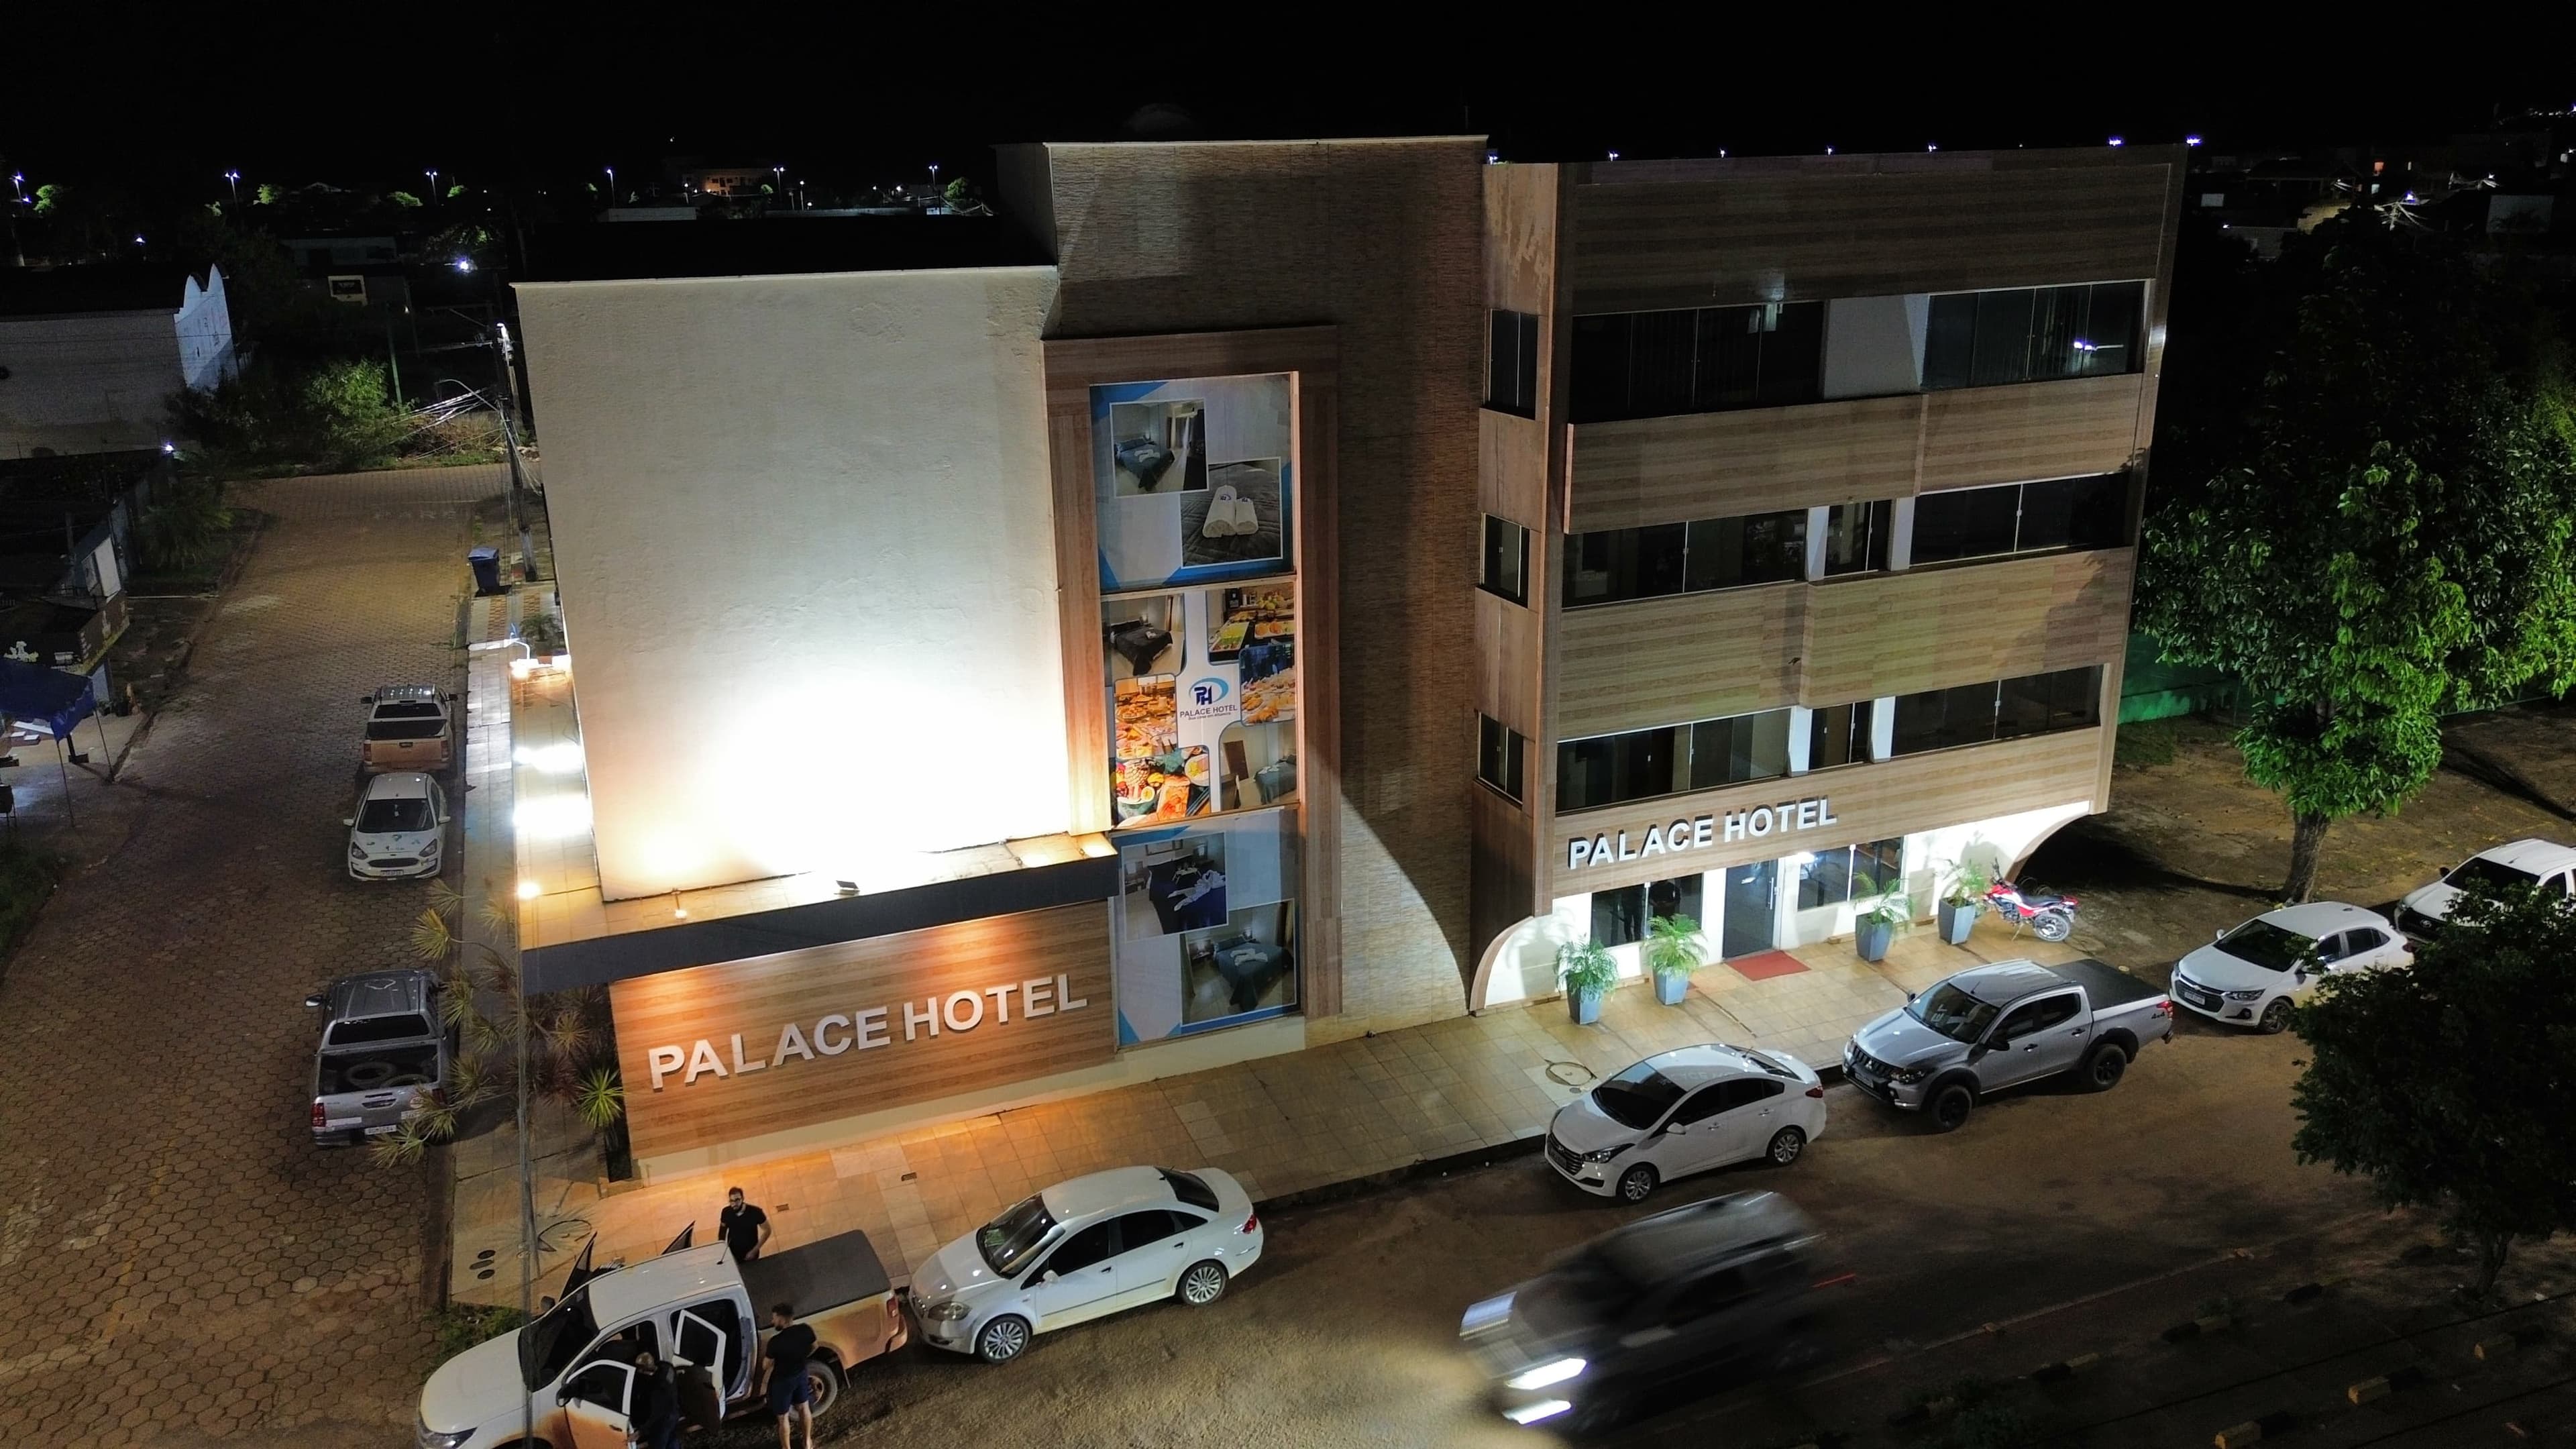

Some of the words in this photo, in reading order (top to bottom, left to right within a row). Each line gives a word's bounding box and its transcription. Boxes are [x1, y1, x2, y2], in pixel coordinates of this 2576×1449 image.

[1180, 708, 1211, 718] PALACE
[1213, 704, 1238, 713] HOTEL
[1568, 815, 1714, 870] PALACE
[1724, 796, 1837, 843] HOTEL
[648, 1006, 892, 1091] PALACE
[903, 973, 1087, 1041] HOTEL
